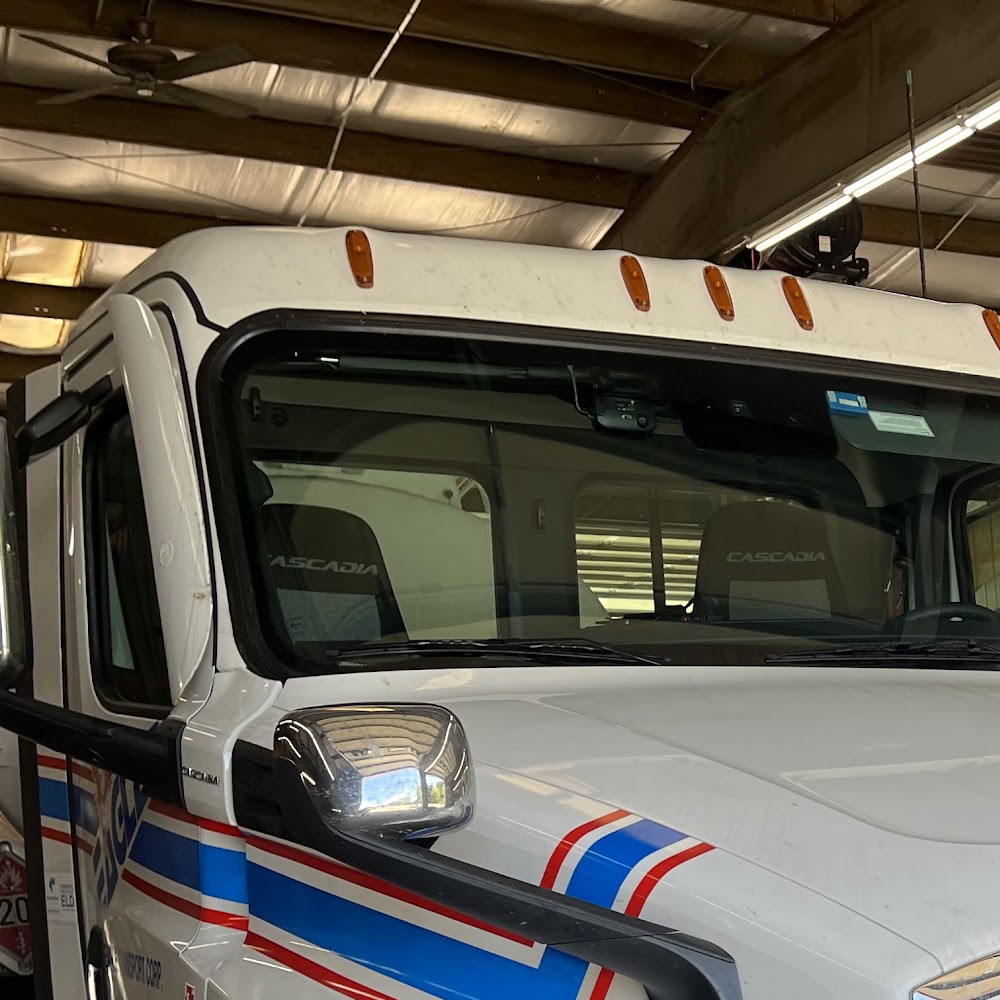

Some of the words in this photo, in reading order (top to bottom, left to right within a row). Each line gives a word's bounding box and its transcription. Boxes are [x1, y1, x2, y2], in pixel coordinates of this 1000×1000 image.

[726, 551, 826, 563] CASCADIA
[267, 554, 379, 576] ASCADIA
[60, 895, 75, 908] ELD
